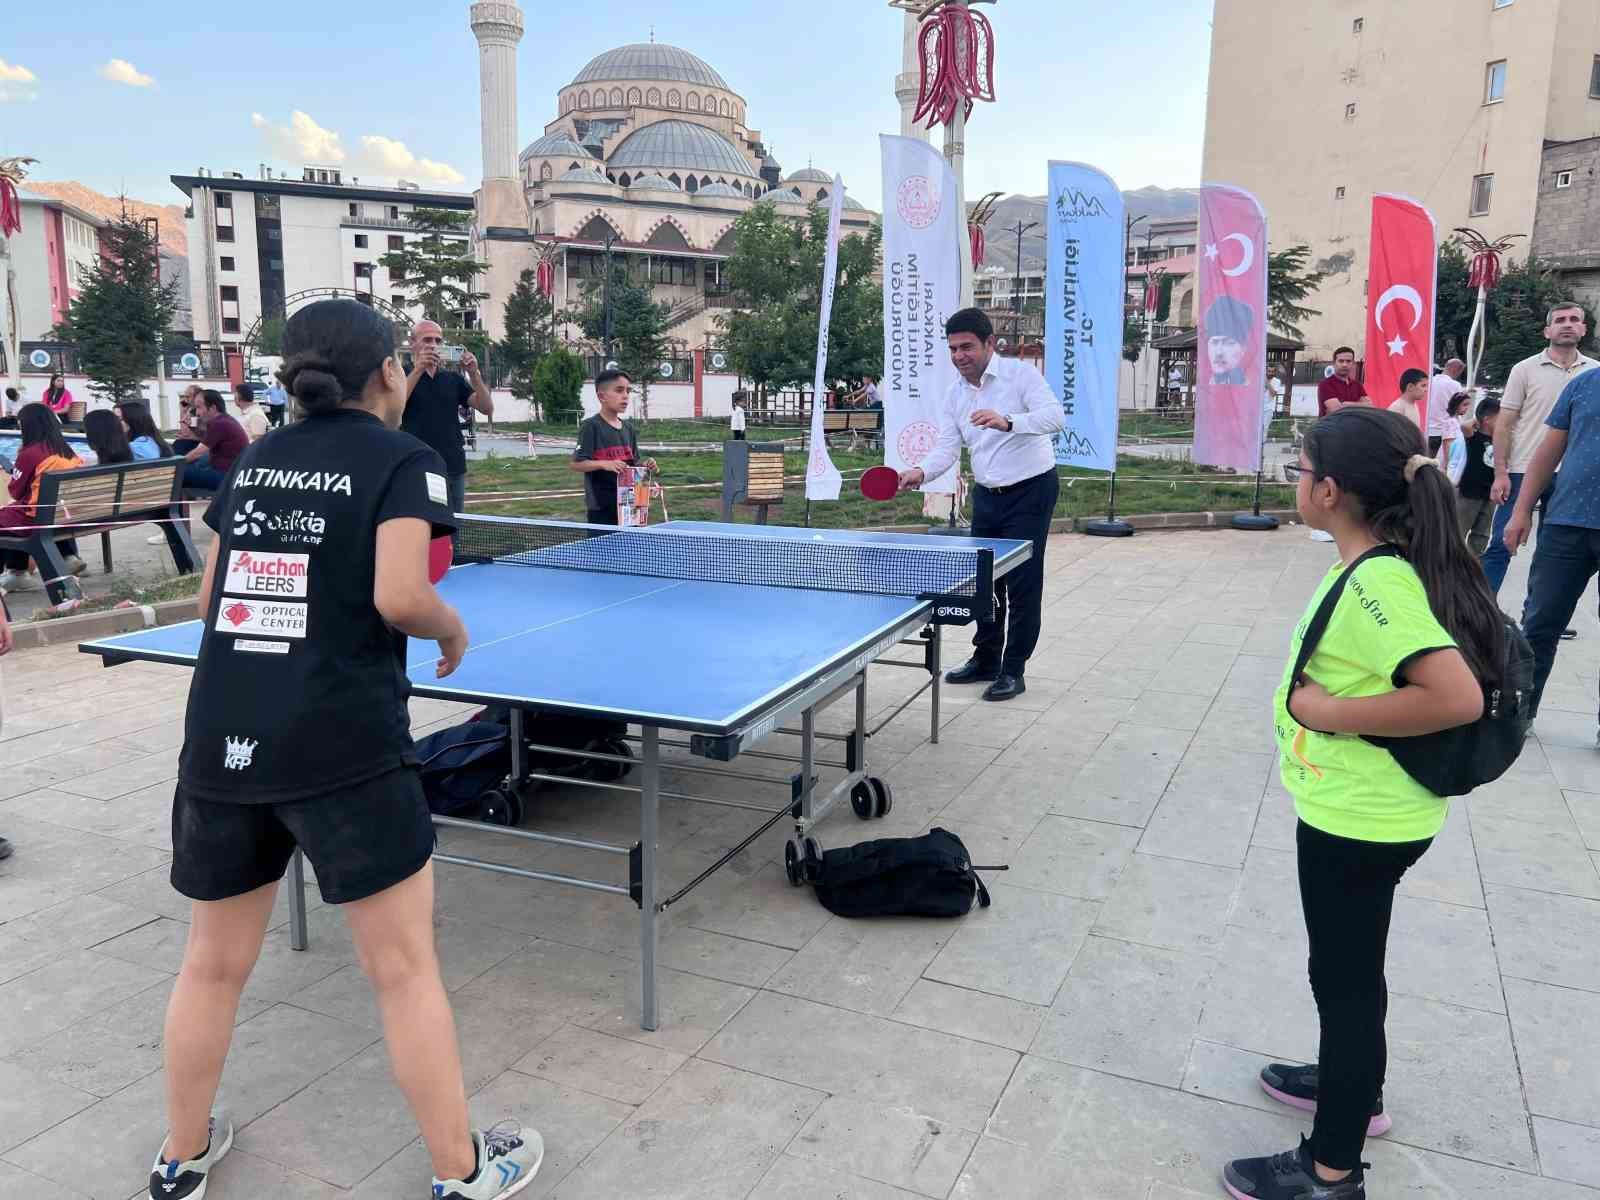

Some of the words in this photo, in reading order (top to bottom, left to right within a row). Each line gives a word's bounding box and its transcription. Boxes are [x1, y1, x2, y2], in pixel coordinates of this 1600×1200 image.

[233, 468, 353, 496] ALTINKAYA
[232, 552, 306, 576] Auchan
[246, 576, 295, 593] LEERS
[262, 606, 305, 617] OPTICAL
[260, 618, 304, 629] CENTER
[224, 753, 252, 770] KFP
